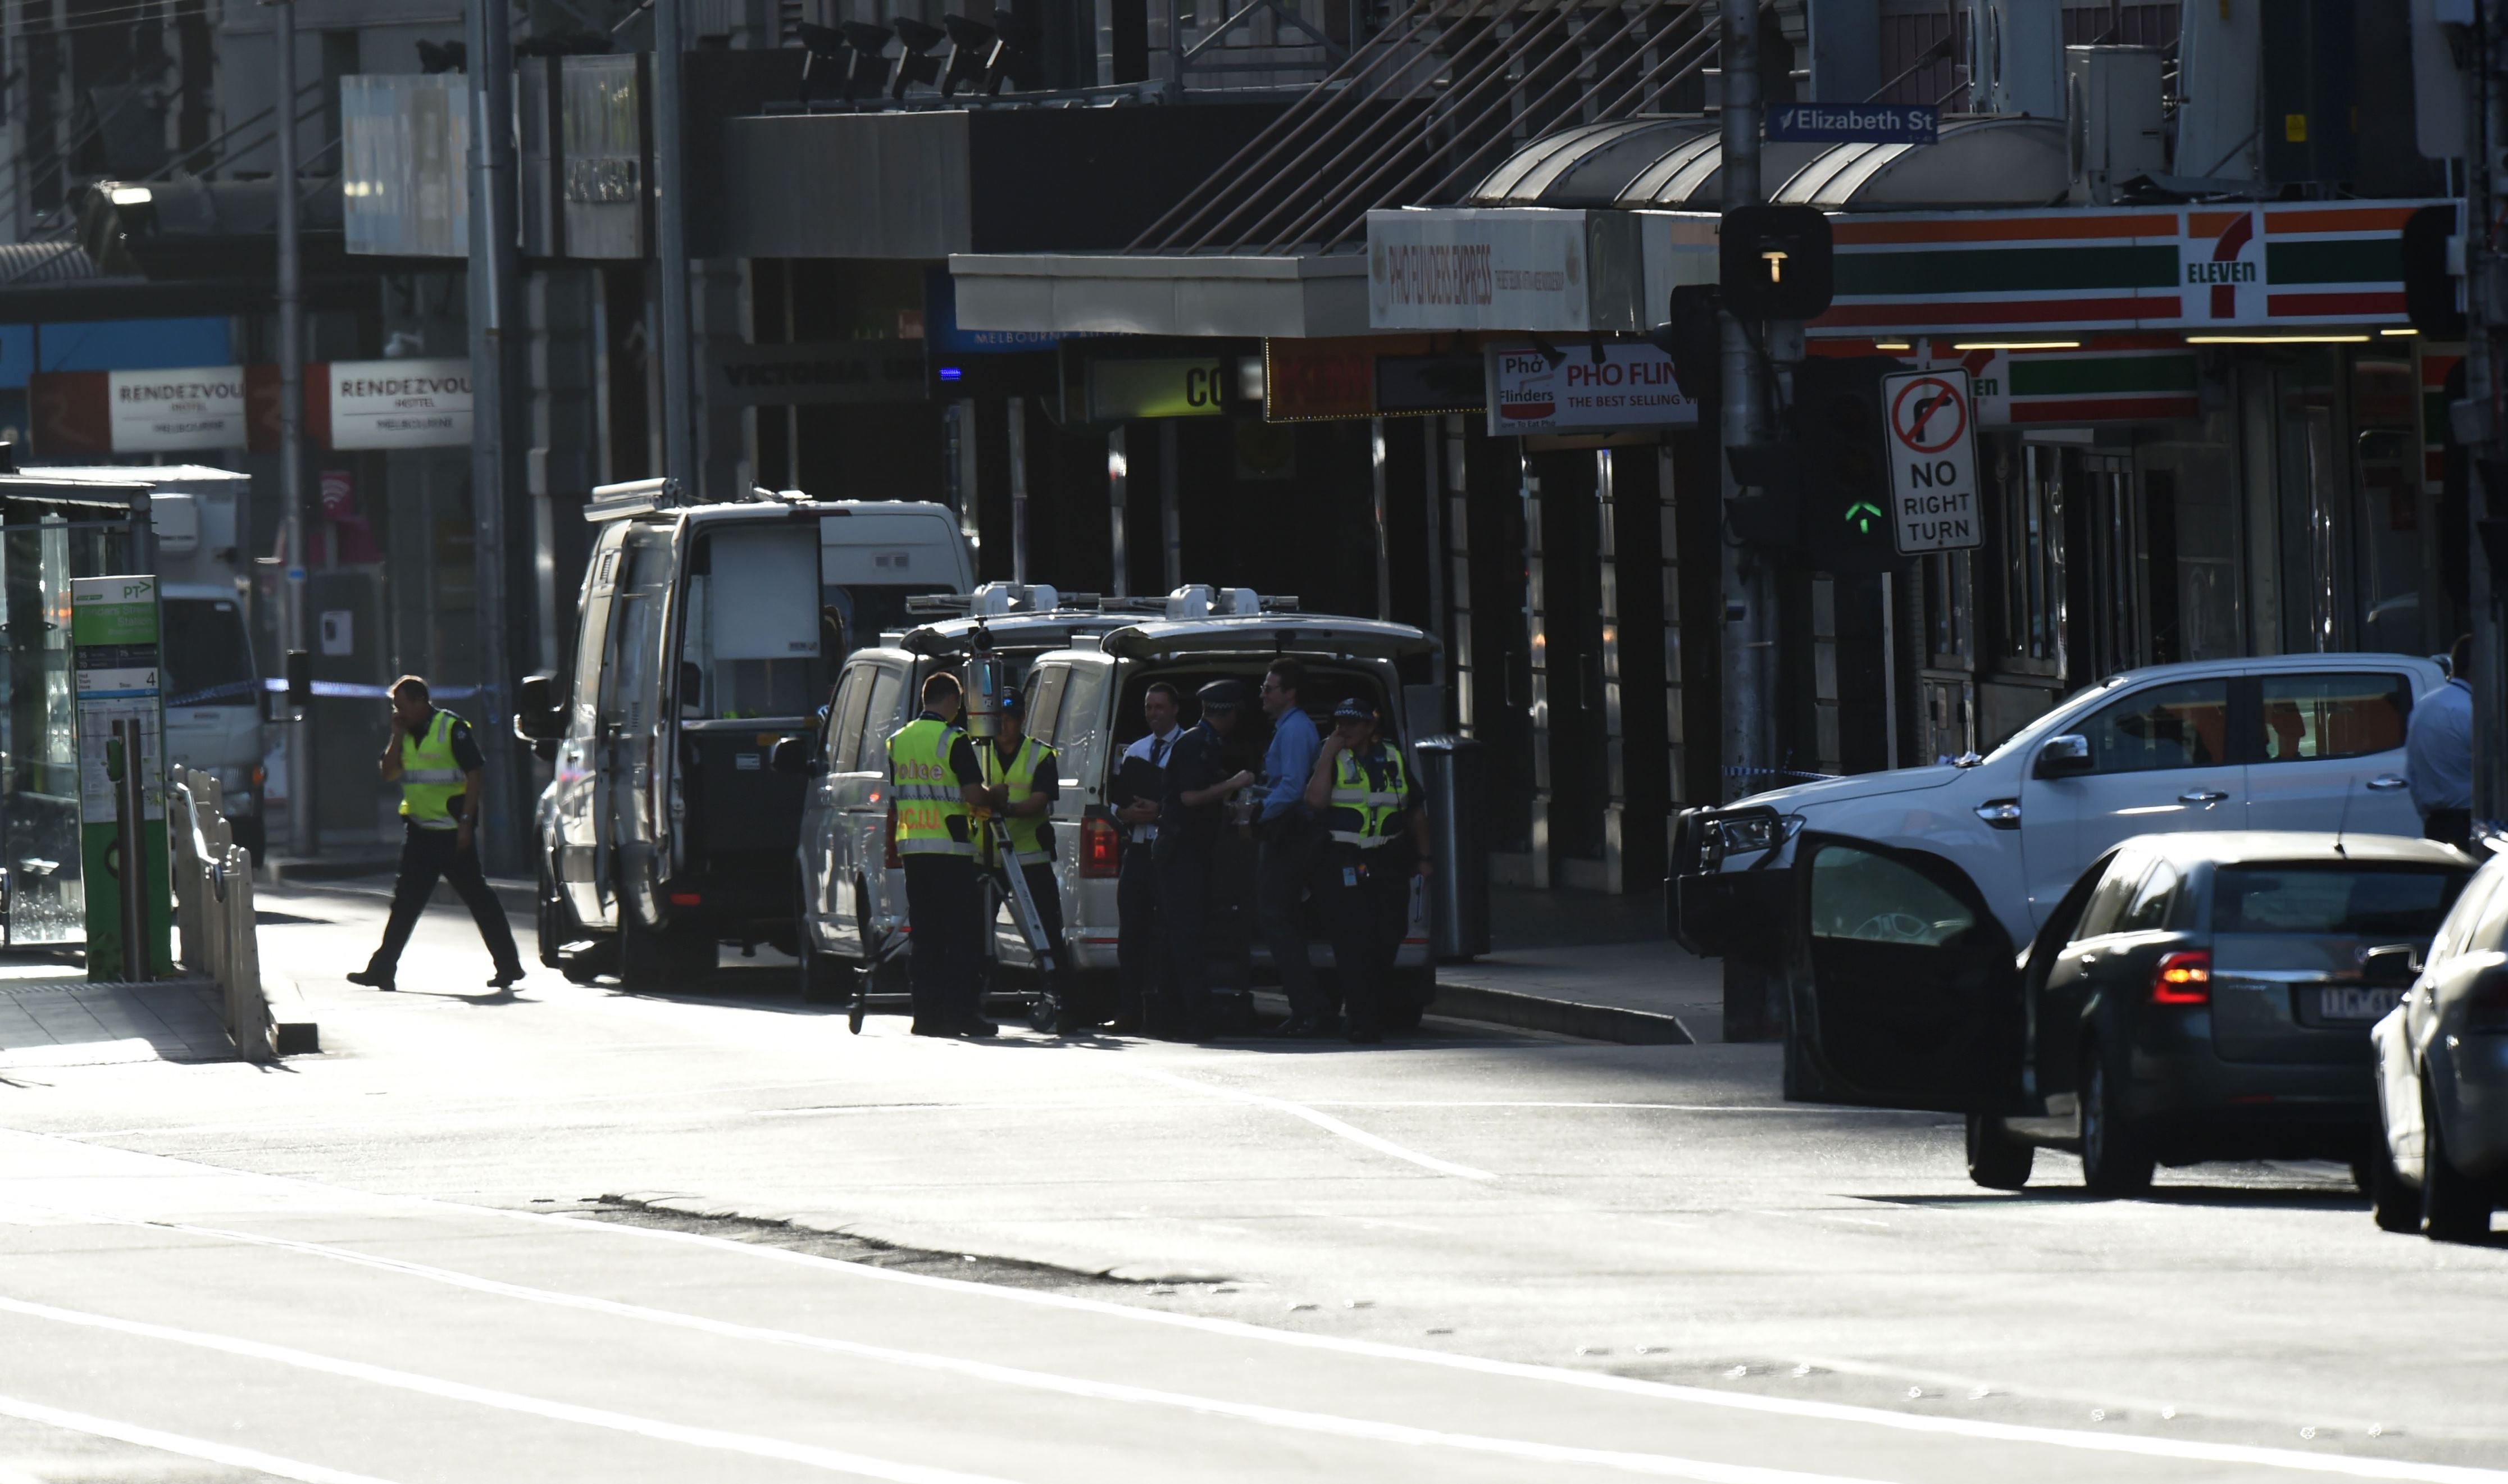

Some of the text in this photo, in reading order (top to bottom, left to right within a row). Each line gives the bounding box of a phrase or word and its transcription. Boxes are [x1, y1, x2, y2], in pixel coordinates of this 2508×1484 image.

[1797, 110, 1933, 130] Elizabeth St
[1389, 245, 1410, 304] PHO
[1453, 244, 1492, 305] EXPRESS
[1567, 362, 1678, 386] PHO FLIN
[341, 377, 473, 397] RENDEZVOU
[1568, 397, 1592, 408] THE
[1596, 395, 1626, 407] BEST
[1629, 394, 1680, 406] SELLING
[1911, 461, 1956, 488] NO
[1904, 493, 1969, 515] RIGHT
[1908, 520, 1969, 541] TURN
[147, 671, 156, 686] 4
